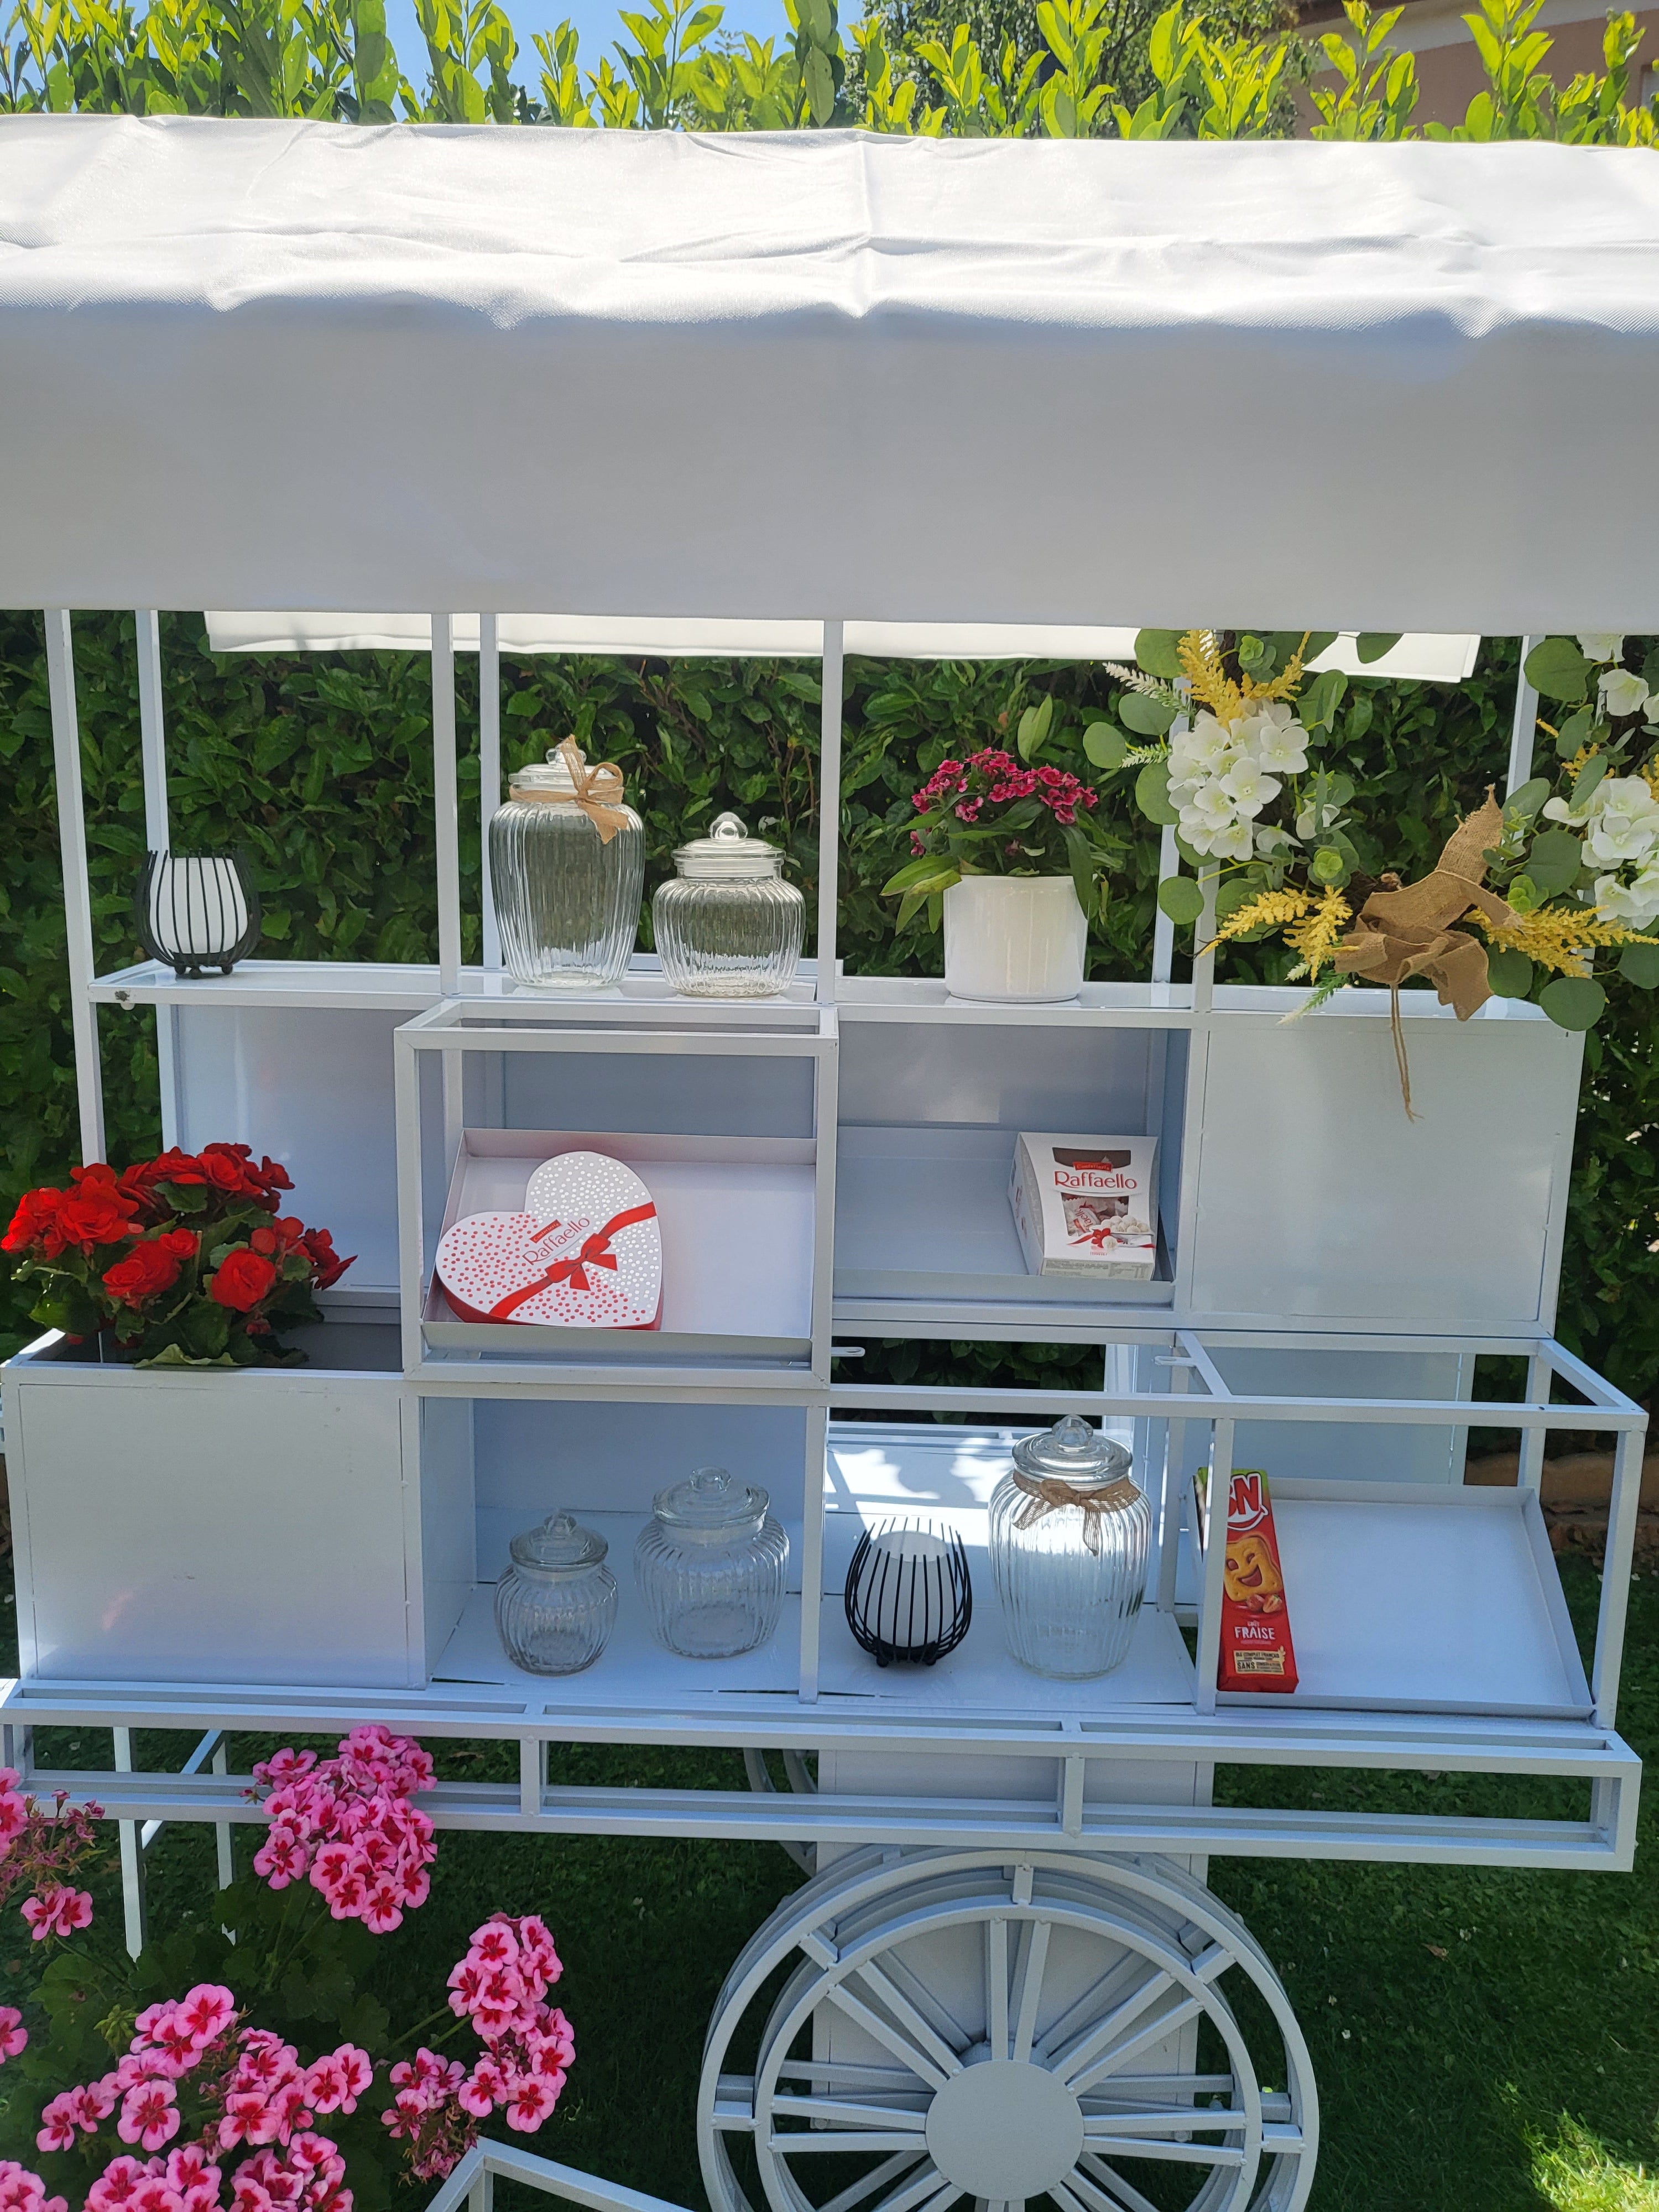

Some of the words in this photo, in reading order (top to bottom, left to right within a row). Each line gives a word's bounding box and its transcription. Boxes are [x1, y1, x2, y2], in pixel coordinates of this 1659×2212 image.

[1054, 1171, 1138, 1189] Raffaello
[521, 1218, 590, 1265] Raffaello
[1234, 1626, 1276, 1640] FRAISE
